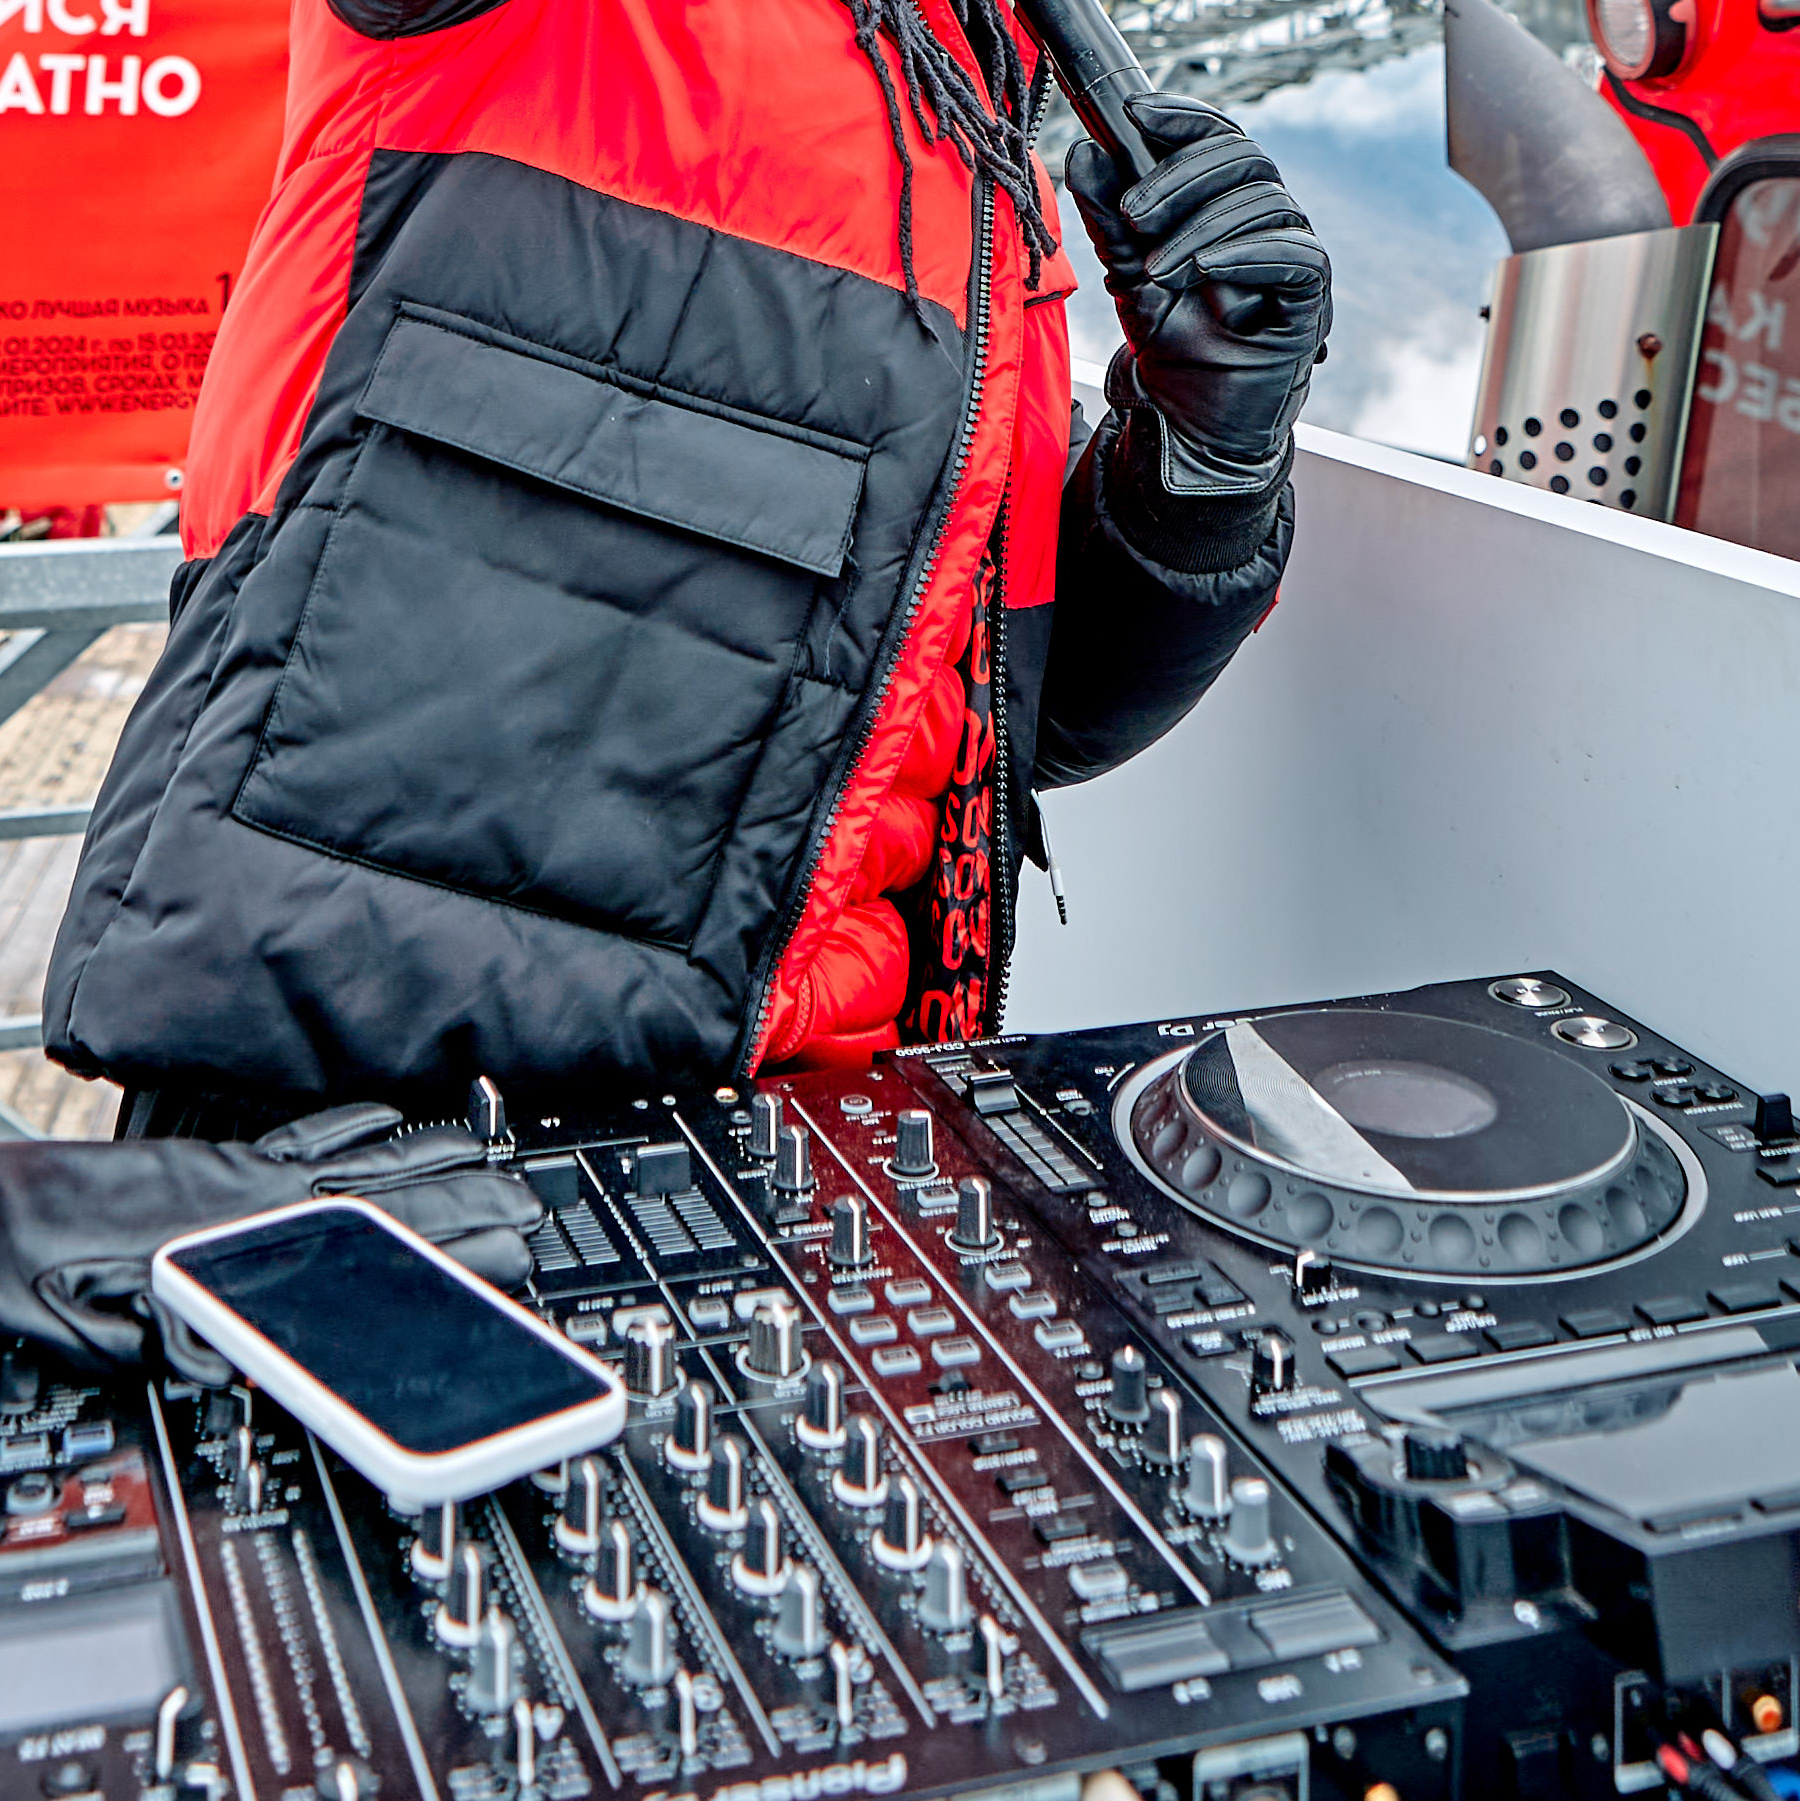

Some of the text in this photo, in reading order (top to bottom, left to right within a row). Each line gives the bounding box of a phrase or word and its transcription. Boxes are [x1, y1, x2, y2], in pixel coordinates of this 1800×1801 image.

[32, 299, 119, 319] ЛУЧШАЯ
[122, 297, 209, 317] МУЗЫКА
[53, 391, 200, 415] WWW.ENERGY
[911, 1405, 1036, 1438] SOUND COLOR FX
